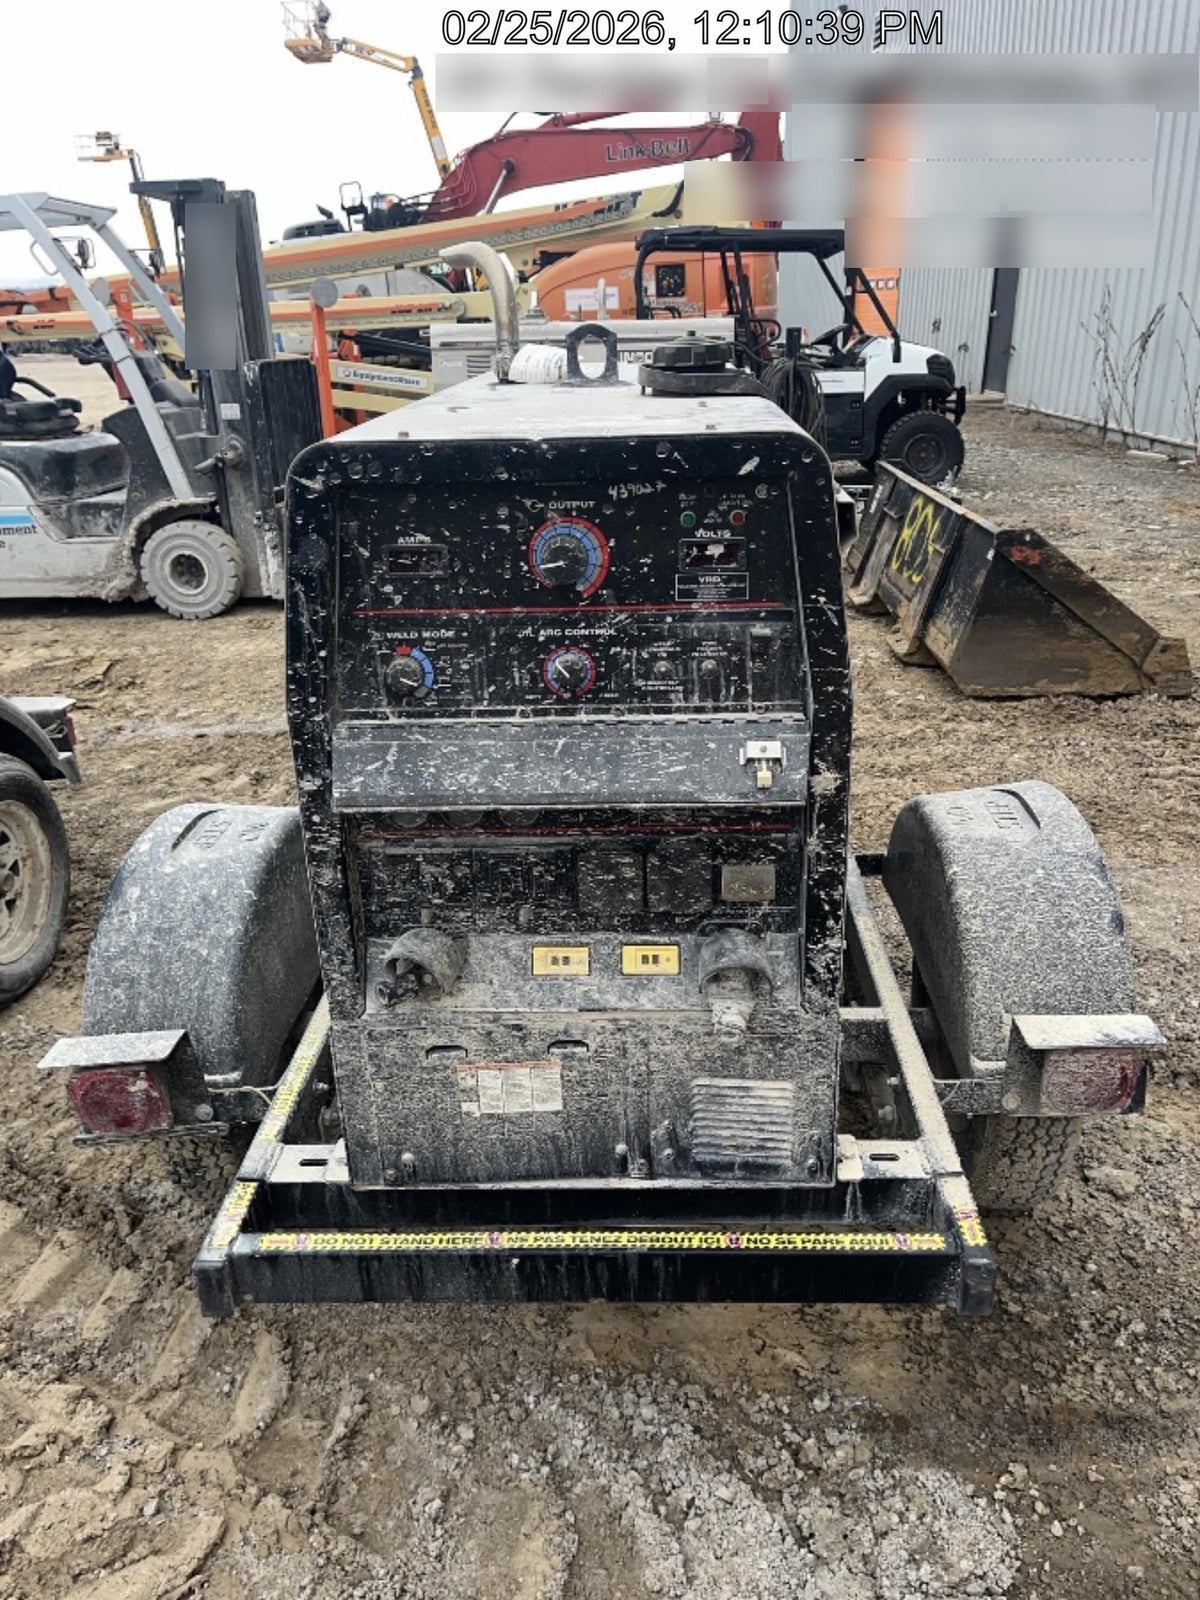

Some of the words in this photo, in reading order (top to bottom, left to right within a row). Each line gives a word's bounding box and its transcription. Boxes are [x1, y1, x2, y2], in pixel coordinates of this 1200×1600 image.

[605, 138, 691, 161] Link-Belt
[548, 500, 596, 509] OUTPUT
[694, 528, 732, 538] VOLTS
[397, 536, 432, 545] AMPS
[386, 631, 419, 639] WELD
[421, 630, 455, 639] MODE
[539, 628, 562, 636] ARC
[565, 628, 617, 636] CONTROL
[313, 1238, 337, 1246] DO
[341, 1238, 375, 1246] NOT
[379, 1237, 434, 1246] STAND
[438, 1236, 483, 1245] HERE
[532, 1235, 566, 1244] PAS
[626, 1235, 695, 1245] DEBOUT
[746, 1236, 771, 1245] NO
[774, 1236, 797, 1245] SE
[800, 1236, 845, 1246] PARE
